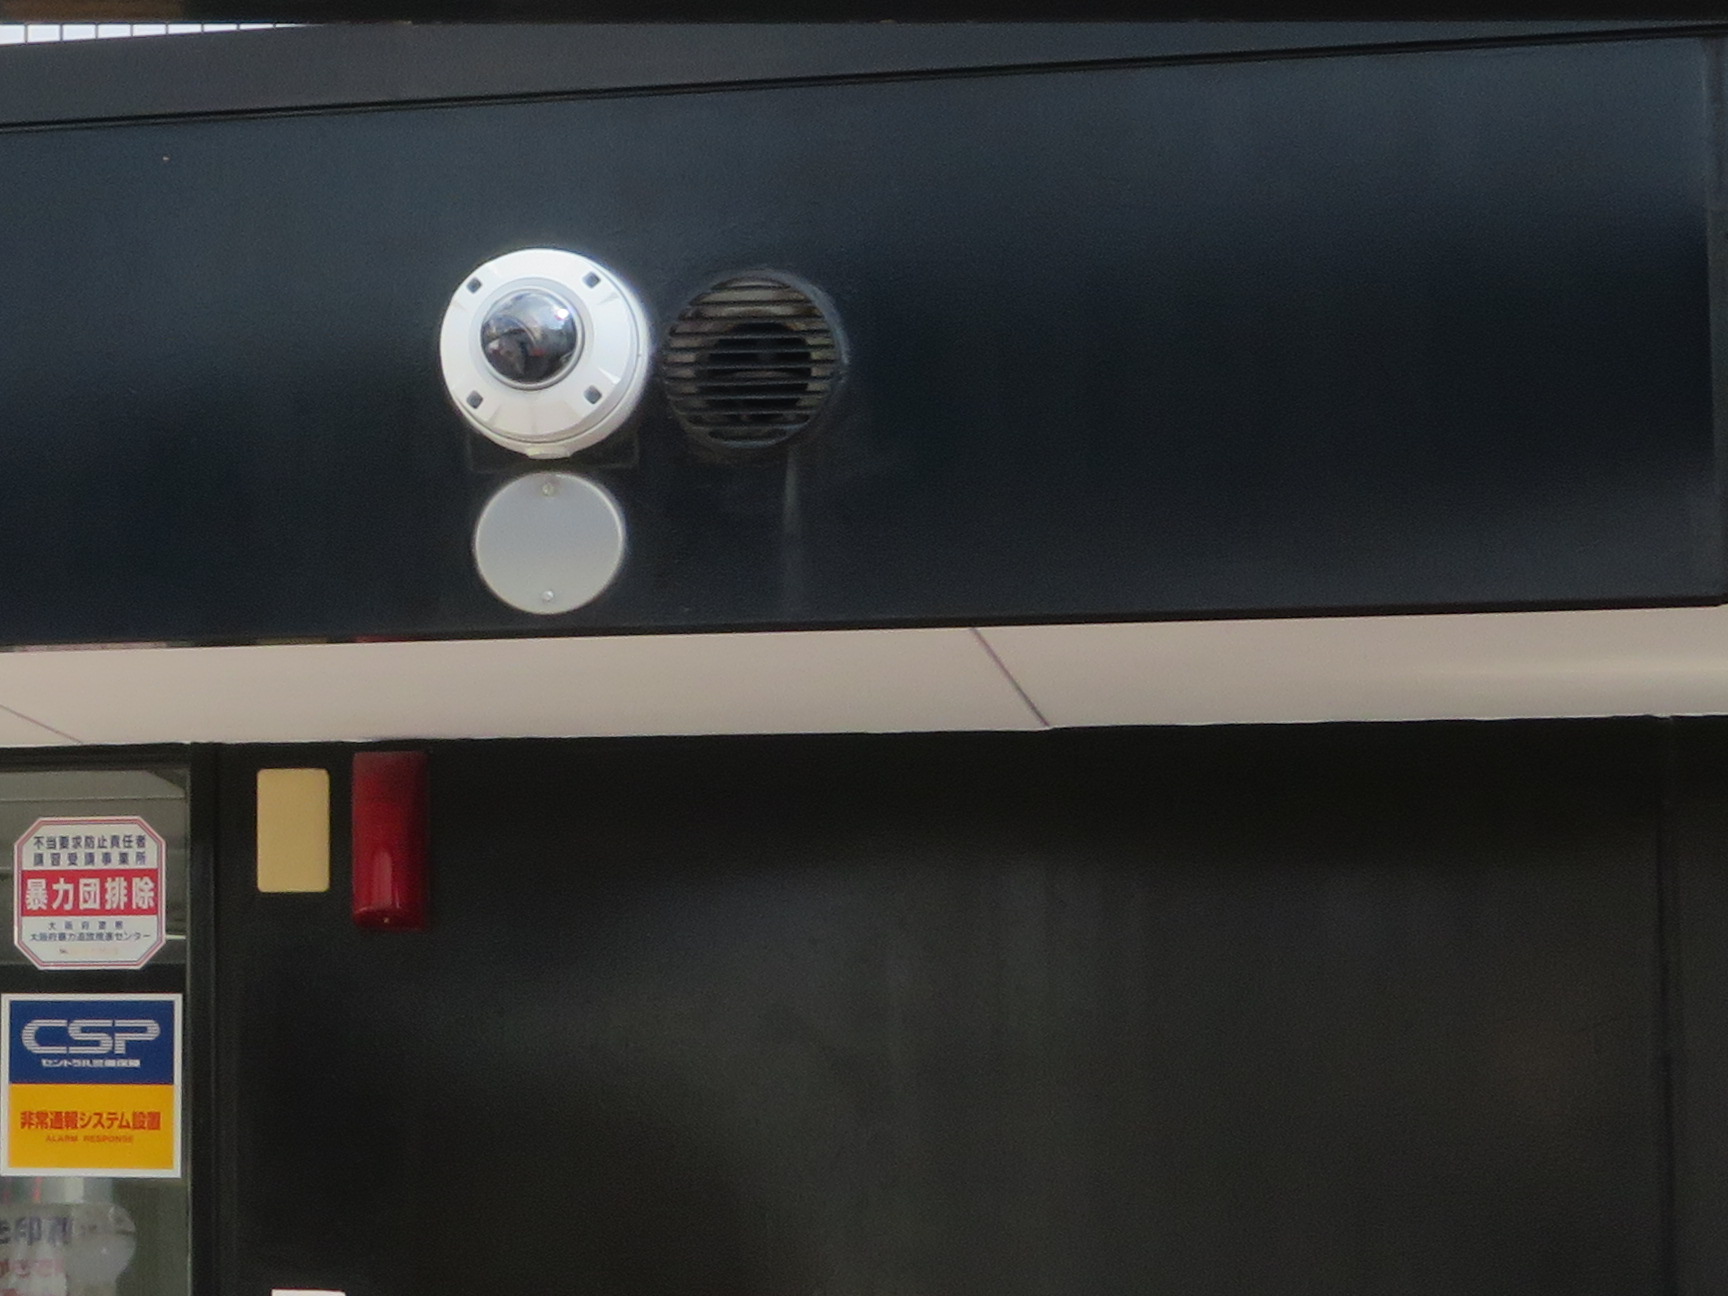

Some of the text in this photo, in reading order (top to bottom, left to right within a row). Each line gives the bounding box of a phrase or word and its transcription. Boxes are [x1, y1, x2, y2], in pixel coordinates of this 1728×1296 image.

[32, 835, 146, 850] 不当要求防止責任者
[25, 877, 156, 911] 暴力団排除
[21, 1019, 161, 1054] CSP
[20, 1110, 162, 1131] 非常通報システム設置
[45, 1135, 134, 1144] ALARM RESPONSE
